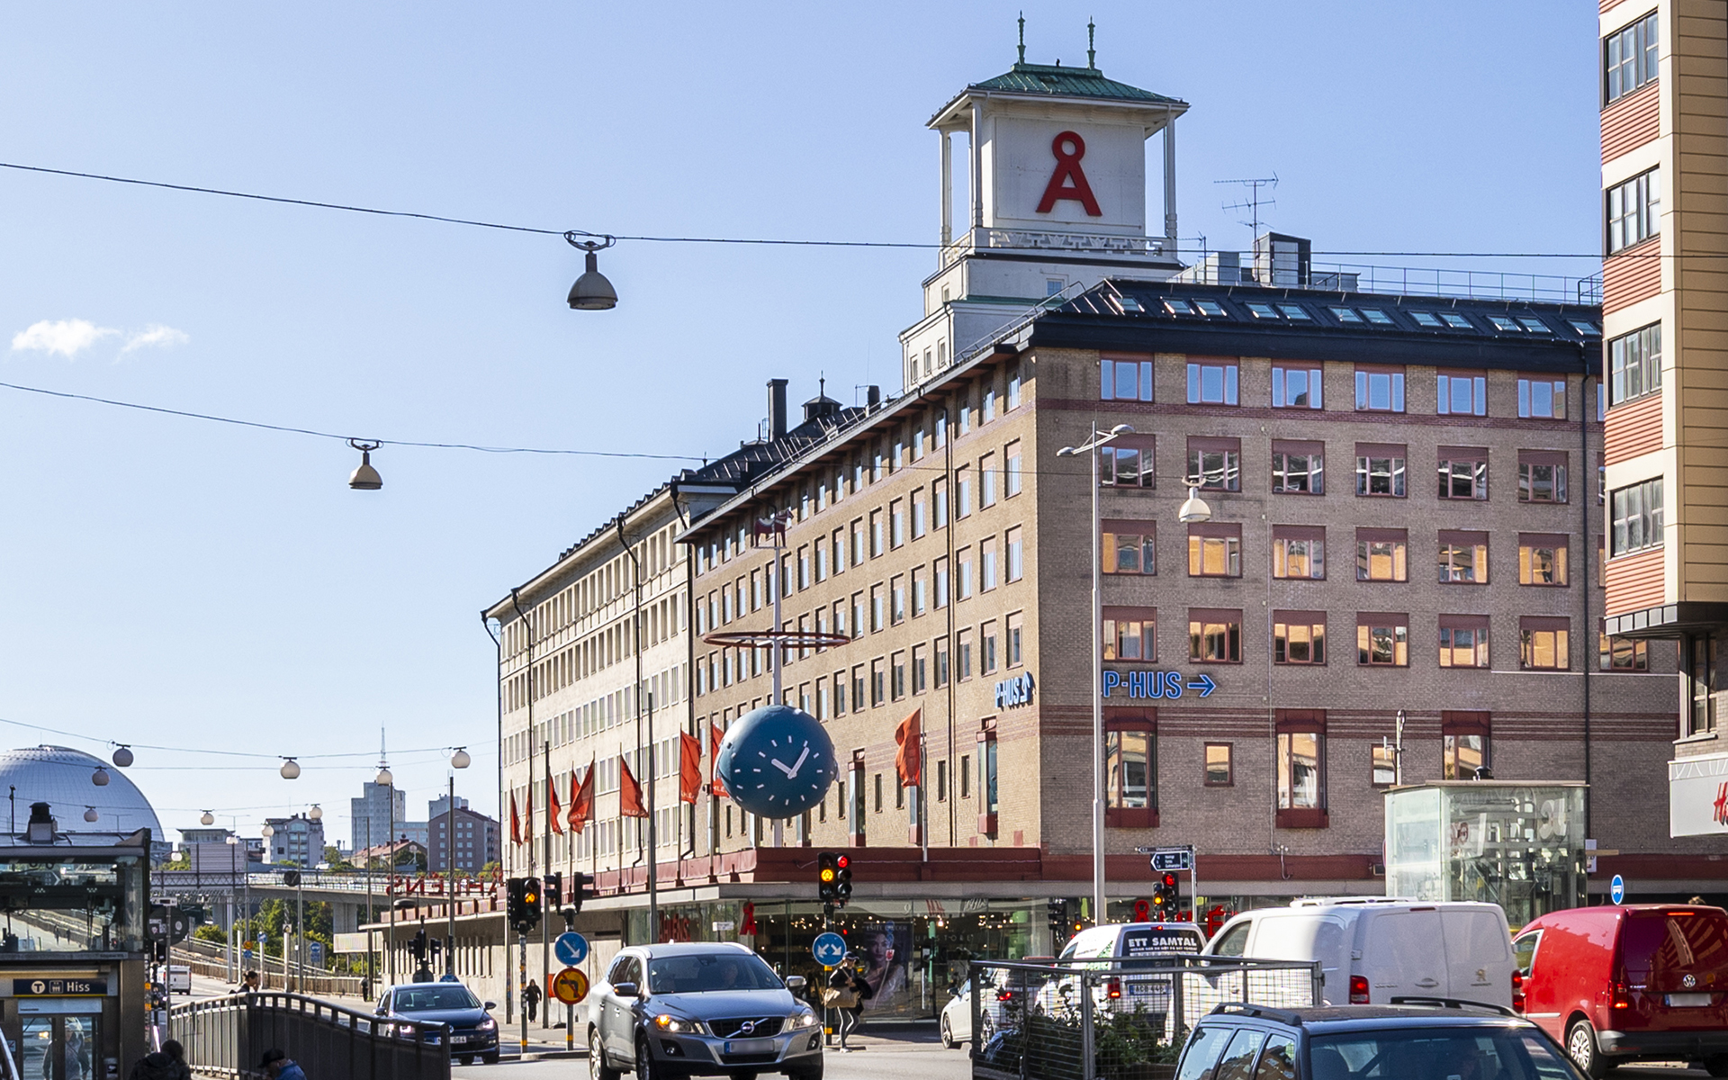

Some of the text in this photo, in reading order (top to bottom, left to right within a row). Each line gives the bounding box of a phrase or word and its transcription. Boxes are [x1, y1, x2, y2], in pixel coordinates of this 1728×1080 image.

[1035, 130, 1103, 217] Å
[1103, 670, 1183, 699] P-HUS
[1128, 936, 1197, 948] ETT SAMTAL
[66, 982, 91, 992] Hiss
